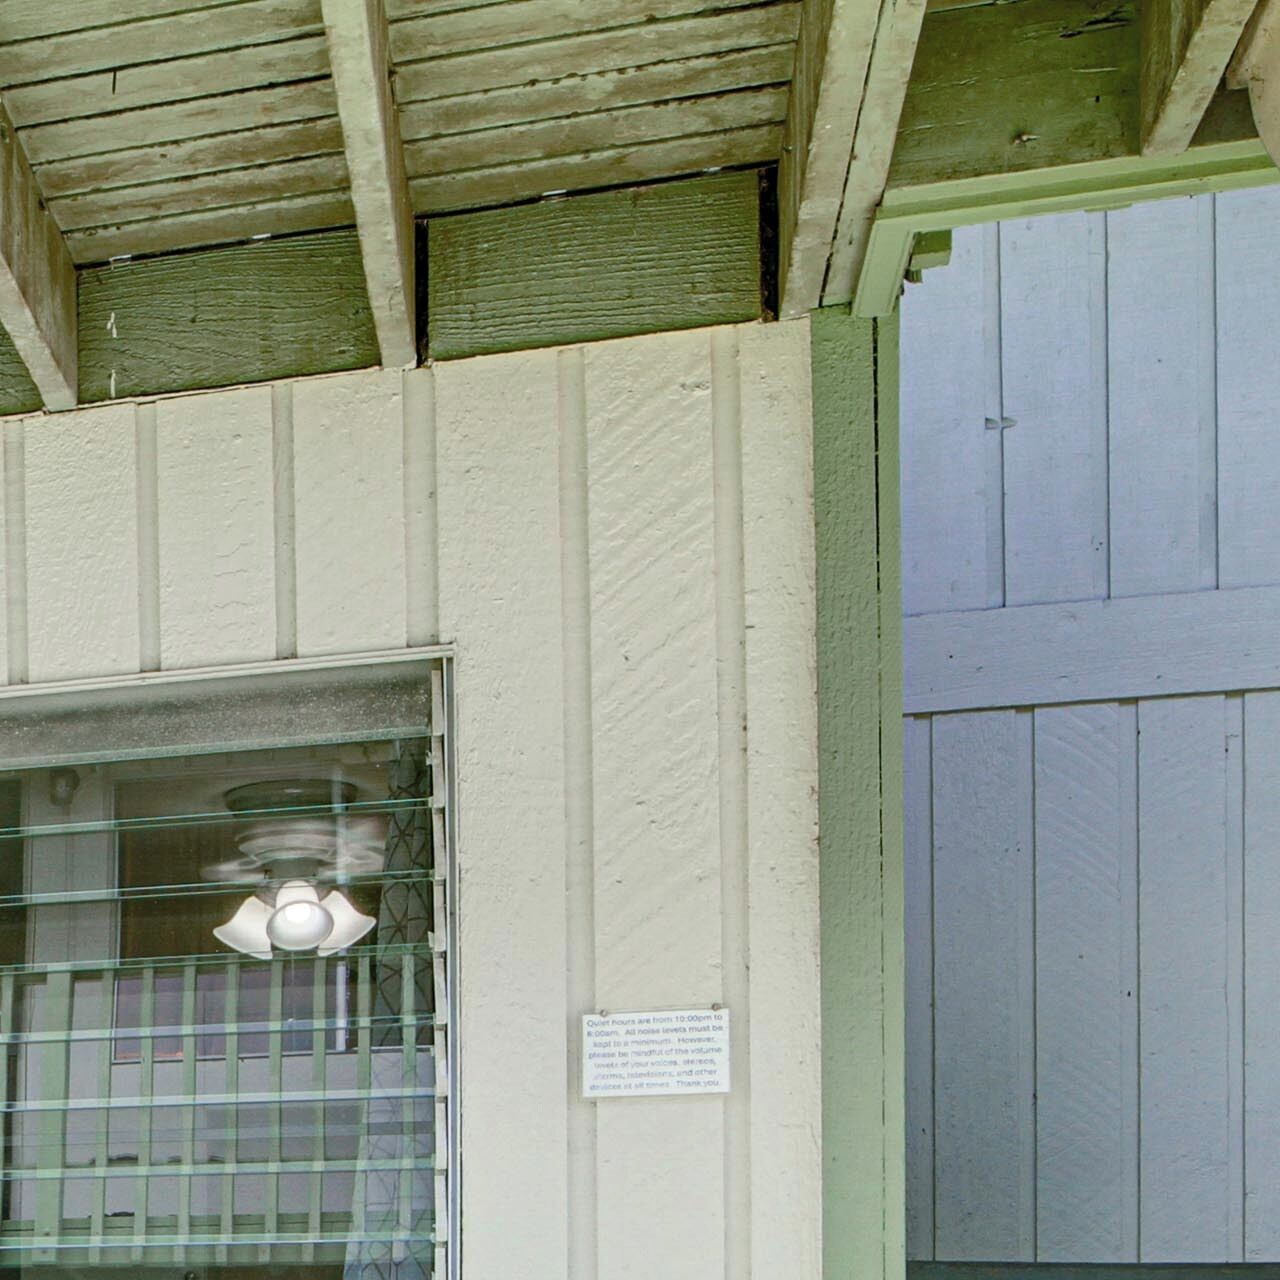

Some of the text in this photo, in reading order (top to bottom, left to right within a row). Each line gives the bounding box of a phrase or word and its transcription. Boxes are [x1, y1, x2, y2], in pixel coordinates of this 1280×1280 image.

[587, 1018, 610, 1027] Quiet
[675, 1015, 712, 1024] 10:00pm
[712, 1024, 723, 1032] be
